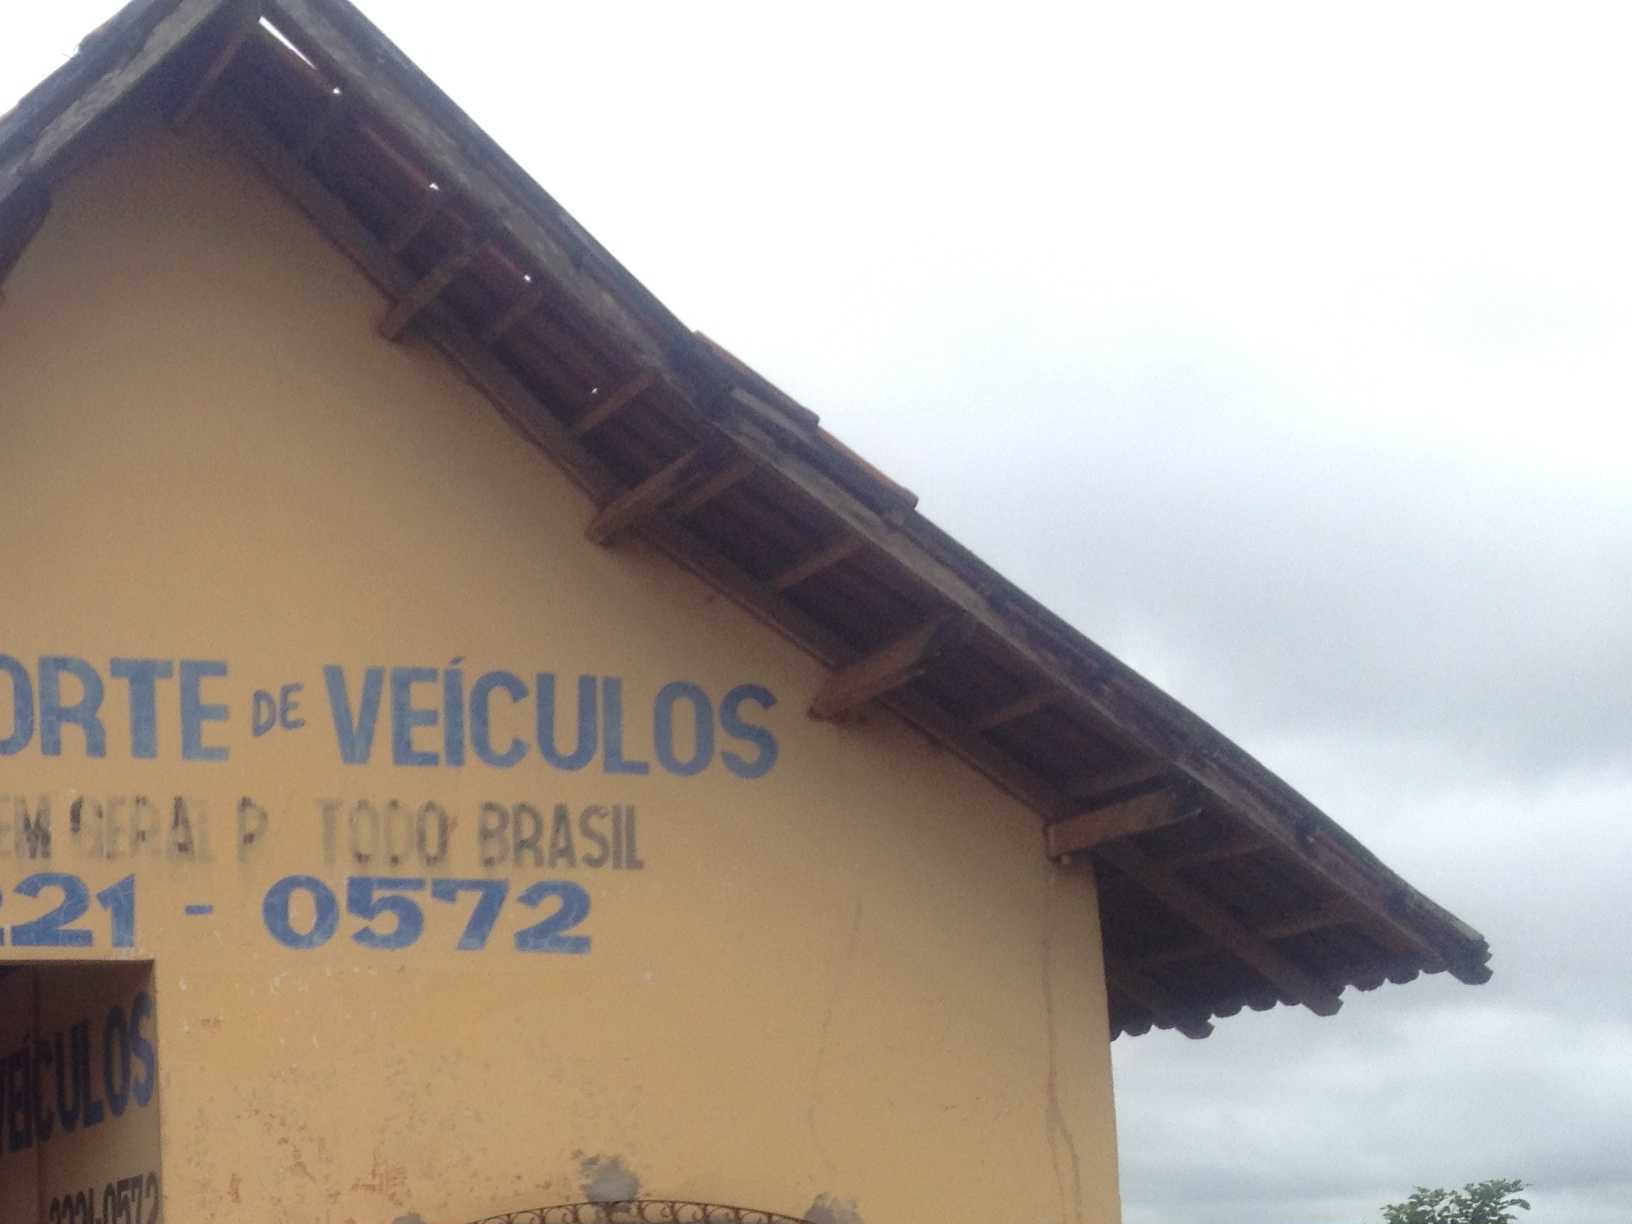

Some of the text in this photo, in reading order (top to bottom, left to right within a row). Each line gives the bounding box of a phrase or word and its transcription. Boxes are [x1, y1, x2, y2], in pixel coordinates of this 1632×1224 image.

[252, 683, 306, 737] DE
[323, 656, 780, 779] VEÍCULOS
[479, 802, 645, 870] BRASIL
